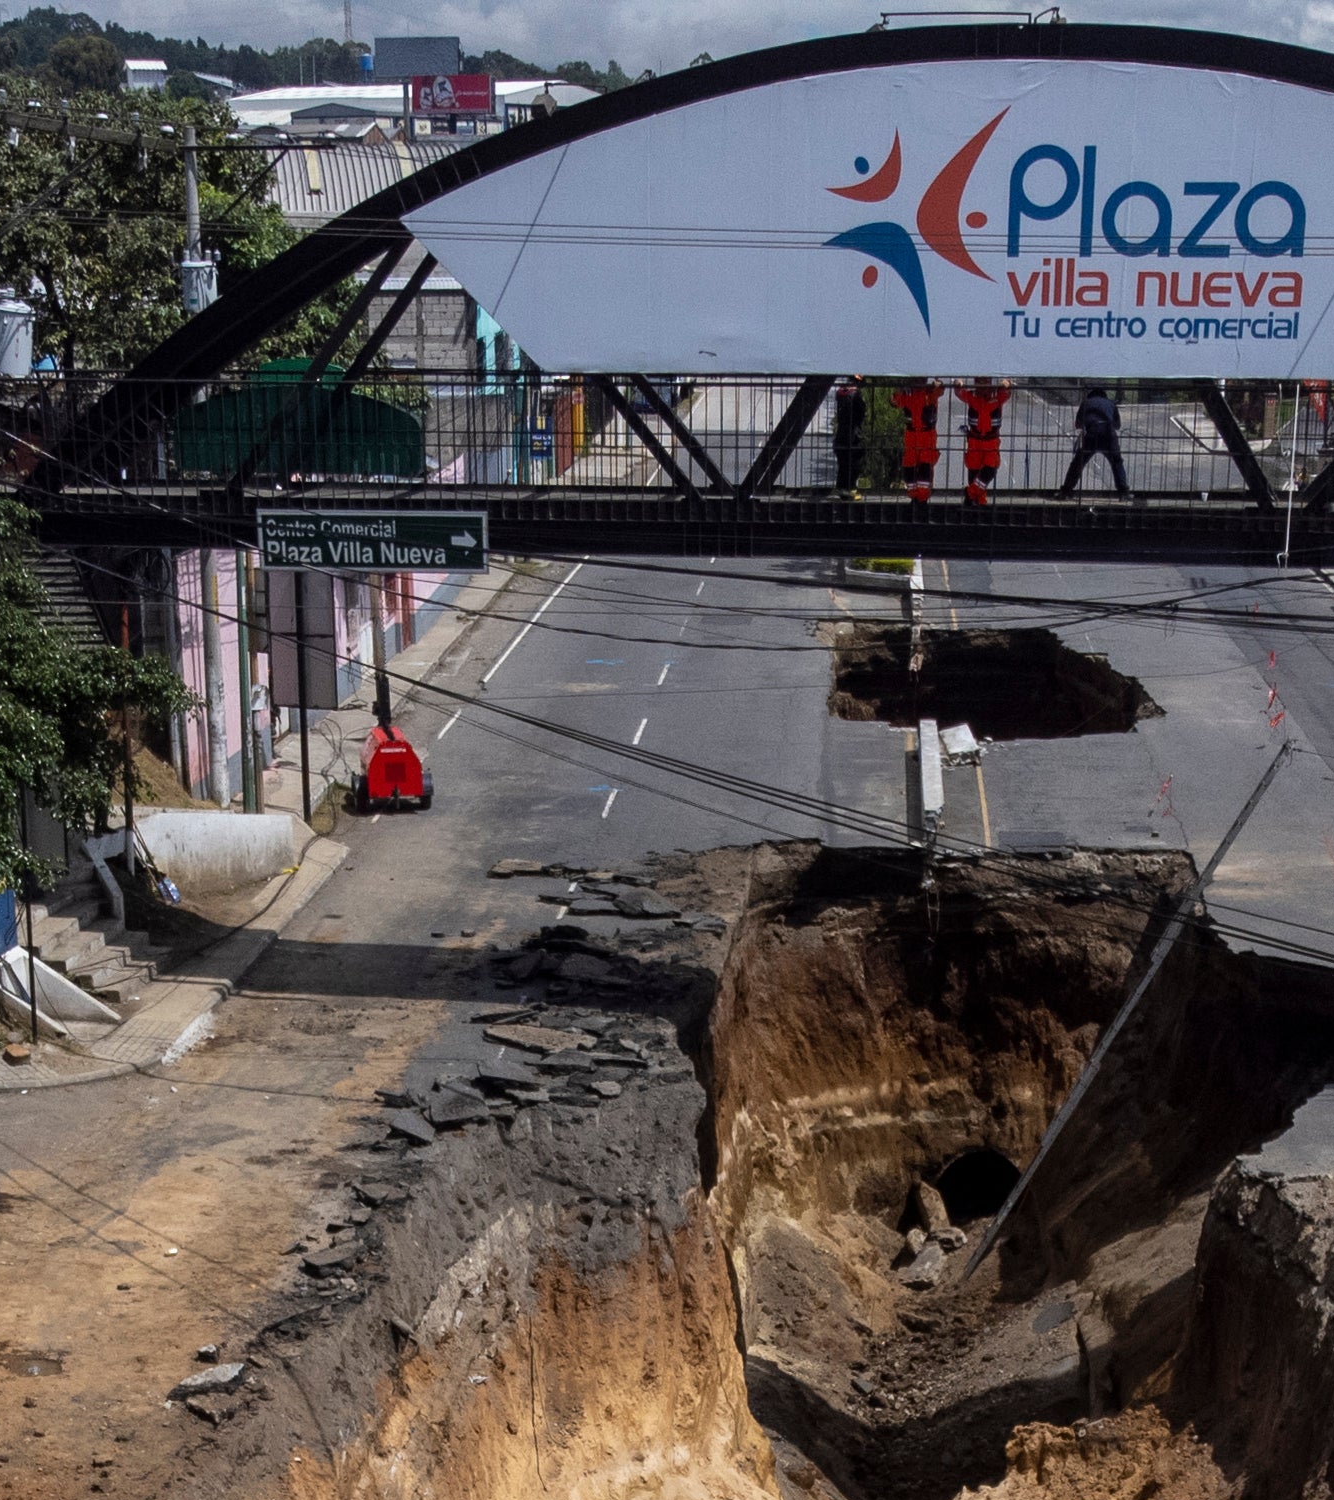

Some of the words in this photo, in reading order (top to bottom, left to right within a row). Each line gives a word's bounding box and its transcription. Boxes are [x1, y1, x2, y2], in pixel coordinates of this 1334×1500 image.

[1006, 143, 1308, 259] Plaza
[1006, 257, 1110, 308] villa
[1136, 270, 1304, 308] nueva
[1003, 310, 1042, 339] Tu
[1054, 310, 1148, 339] centro
[1158, 310, 1301, 341] comercial
[266, 519, 316, 537] Centro
[320, 520, 397, 538] Comercial
[267, 540, 323, 564] Plaza
[328, 541, 374, 564] Villa
[381, 542, 447, 565] Nueva
